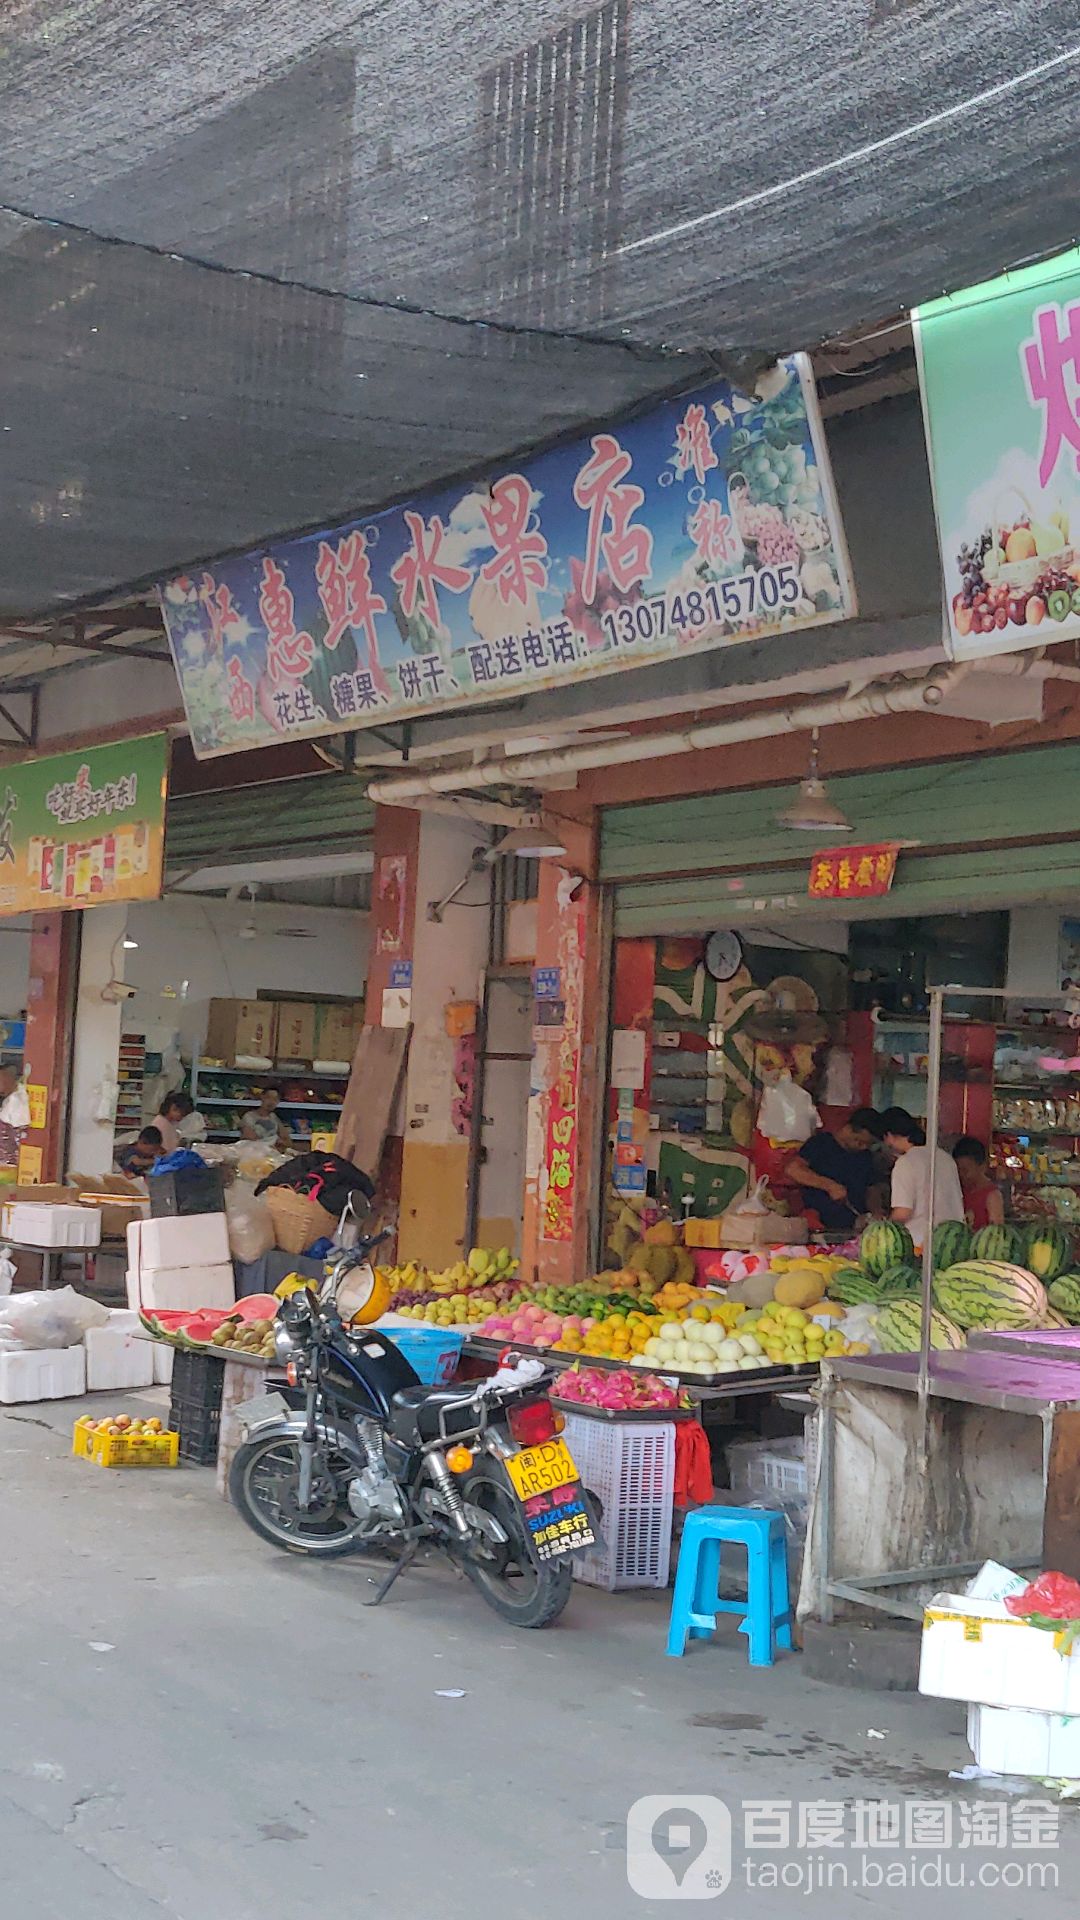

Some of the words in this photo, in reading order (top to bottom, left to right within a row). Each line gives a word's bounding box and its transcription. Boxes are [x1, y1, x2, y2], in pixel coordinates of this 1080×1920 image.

[260, 434, 653, 694] 惠鲜水果店
[203, 572, 254, 722] 江西
[519, 1459, 575, 1496] AR502
[528, 1500, 585, 1532] SUZUKI
[532, 1513, 588, 1545] 加佳车行
